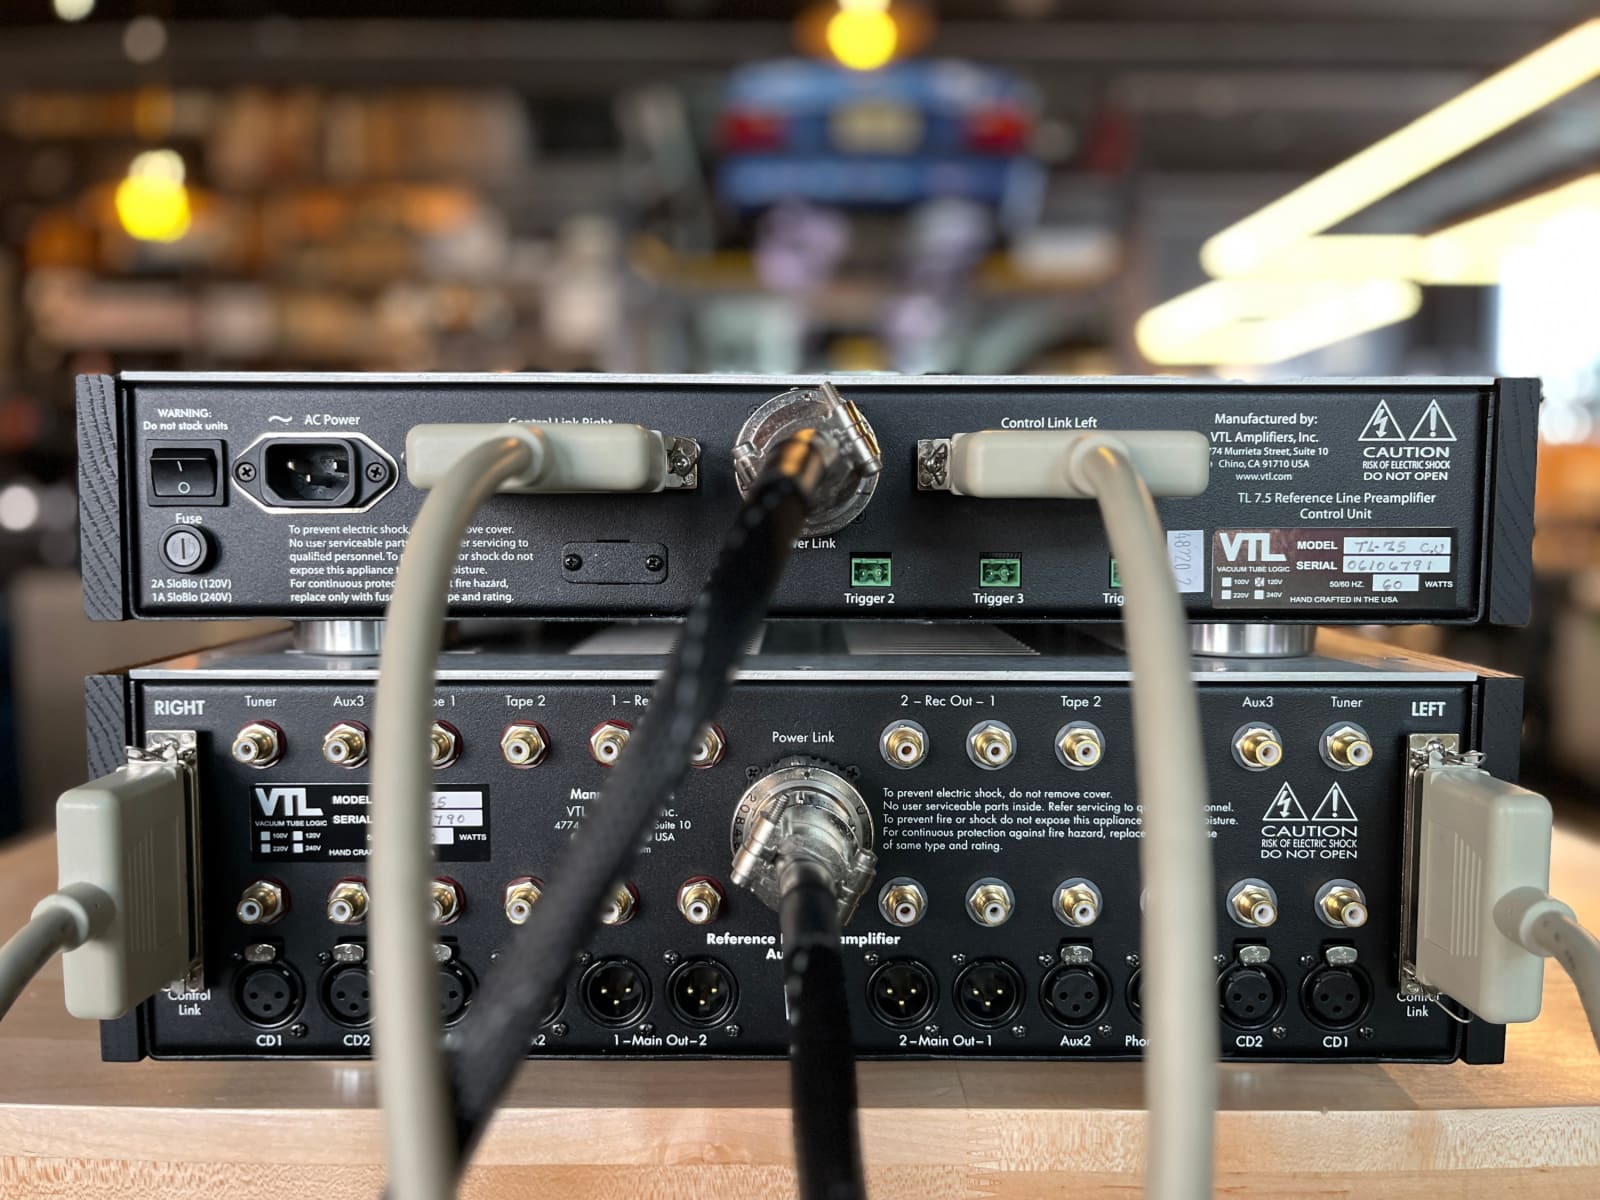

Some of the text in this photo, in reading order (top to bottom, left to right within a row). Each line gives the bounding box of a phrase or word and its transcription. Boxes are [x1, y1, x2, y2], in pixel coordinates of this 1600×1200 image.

[156, 408, 212, 418] WARNING:
[142, 420, 228, 430] Do not units
[303, 414, 360, 425] AC Power
[1000, 416, 1098, 428] Control Link Left
[1214, 412, 1317, 427] Manufactured by:
[1210, 430, 1319, 444] VTL Amplifiers, Inc.
[1224, 446, 1329, 456] Murrieta Street, Suite 10
[1362, 446, 1449, 458] CAUTION
[1218, 459, 1310, 468] Chino, CA 91710 USA
[1362, 460, 1450, 469] RISK OF ELECTRIC SHOCK
[1235, 471, 1292, 480] www.vtl.com
[1363, 471, 1448, 480] DO NOT OPEN
[1237, 491, 1436, 506] TL 7.5 Reference Line Preamplifier
[175, 512, 202, 524] Fuse
[1299, 508, 1372, 519] Control Unit
[287, 524, 378, 536] To prevent electric
[288, 537, 383, 548] No serviceable
[811, 537, 836, 548] Link
[1218, 532, 1287, 561] VTL
[1296, 540, 1338, 550] MODEL
[333, 551, 399, 562] personnel. To
[289, 564, 394, 576] expose this appliance
[1295, 560, 1338, 570] SERIAL
[150, 578, 231, 589] 2A SloBlo (120V)
[289, 578, 363, 588] For continuous
[1424, 580, 1453, 588] WATTS
[151, 591, 232, 602] 1A SloBlo (240V)
[290, 591, 373, 604] replace only with
[843, 592, 895, 606] Trigger 2
[972, 592, 1024, 606] Trigger 3
[244, 694, 277, 707] Tuner
[332, 694, 364, 706] Aux3
[504, 694, 545, 709] Tape 2
[900, 694, 994, 706] 2 Rec Out 1
[1060, 695, 1101, 710] Tape 2
[1241, 695, 1273, 707] Aux3
[1330, 695, 1363, 708] Tuner
[154, 699, 205, 715] RIGHT
[1411, 701, 1446, 716] LEFT
[772, 730, 834, 742] Power Link
[332, 794, 373, 805] MODEL
[882, 787, 894, 797] To
[897, 788, 933, 800] prevent
[936, 787, 971, 798] electric
[974, 787, 1005, 799] shock,
[1008, 787, 1022, 798] do
[1025, 789, 1041, 798] not
[1043, 791, 1080, 799] remove
[255, 787, 323, 816] VTL
[883, 801, 899, 810] No
[925, 800, 981, 812] serviceable
[984, 802, 1009, 814] parts
[1012, 800, 1044, 811] inside.
[1048, 800, 1074, 812] Refer
[1076, 802, 1121, 814] servicing
[332, 814, 373, 824] SERIAL
[883, 812, 1143, 828] To prevent fire shock do not expose this appliance
[883, 826, 1147, 840] For continuous protection against fire hazard, replace
[1261, 825, 1357, 837] CAUTION
[882, 839, 1003, 853] of same type and rating.
[1261, 838, 1357, 848] RISK OF ELECTRIC SHOCK
[1260, 849, 1357, 859] DO NOT OPEN
[706, 931, 776, 944] Reference
[178, 1002, 201, 1015] Link
[1406, 1004, 1428, 1016] Link
[255, 1034, 282, 1046] CD1
[343, 1034, 371, 1046] CD2
[1059, 1034, 1091, 1046] Aux2
[1235, 1035, 1263, 1047] CD2
[1322, 1035, 1348, 1048] CD1
